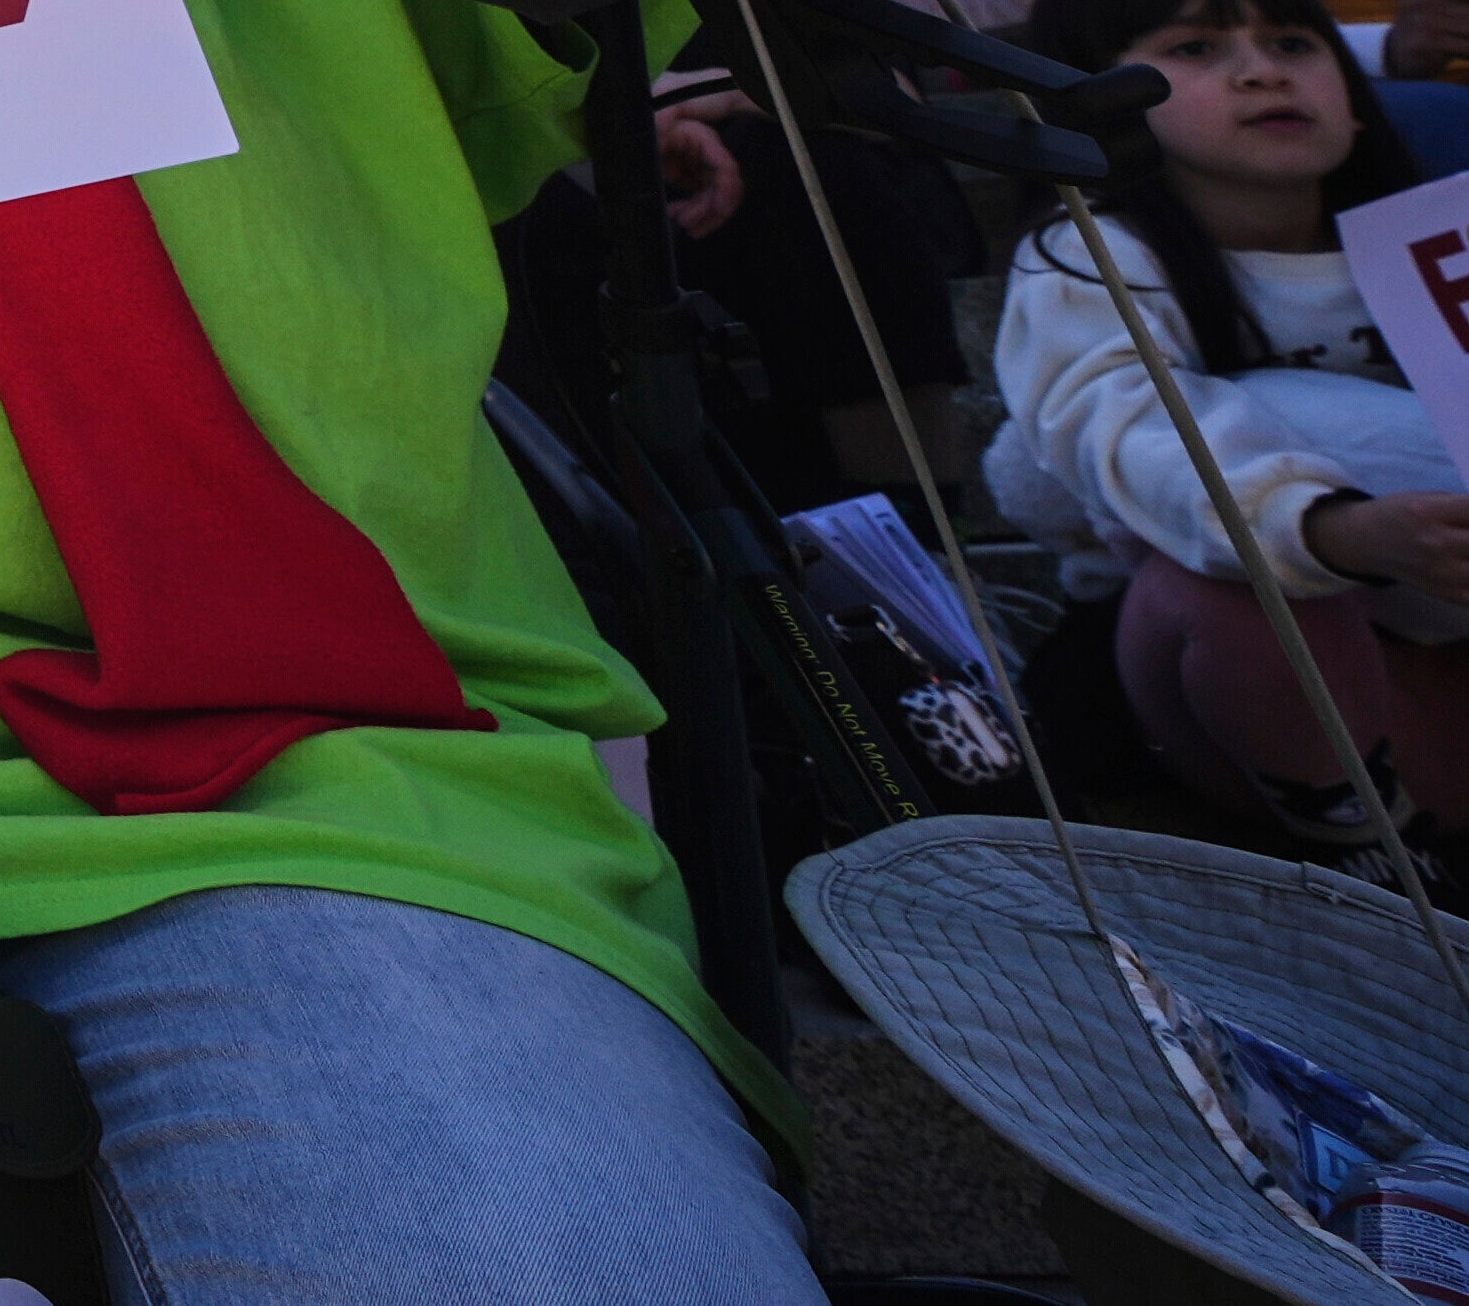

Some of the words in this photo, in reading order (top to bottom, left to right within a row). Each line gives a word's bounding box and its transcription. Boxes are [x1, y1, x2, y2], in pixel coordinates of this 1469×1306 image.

[815, 670, 840, 698] Do
[836, 702, 867, 738] Not
[860, 741, 901, 796] Move
